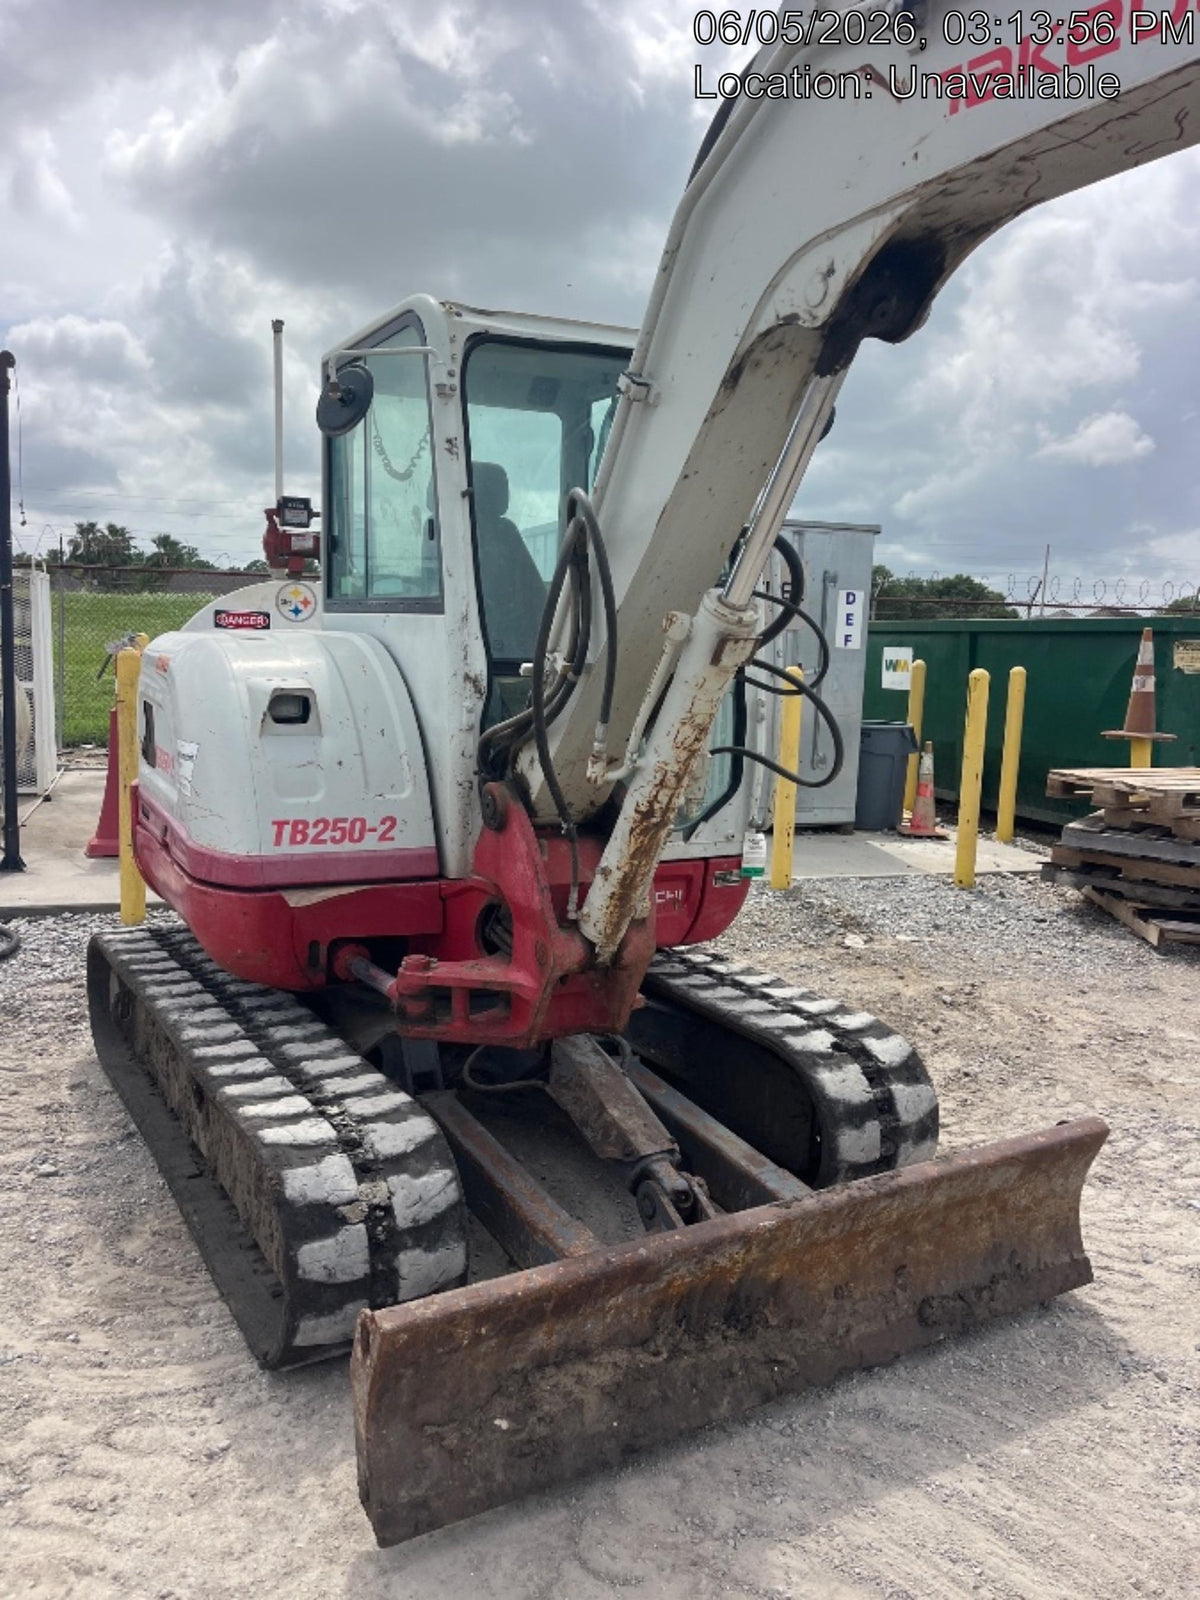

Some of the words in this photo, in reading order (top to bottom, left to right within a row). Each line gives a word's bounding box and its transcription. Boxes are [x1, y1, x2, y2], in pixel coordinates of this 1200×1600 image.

[221, 614, 264, 626] DANGER
[844, 591, 857, 647] DEF
[884, 659, 910, 672] WM
[271, 815, 398, 847] TB250-2
